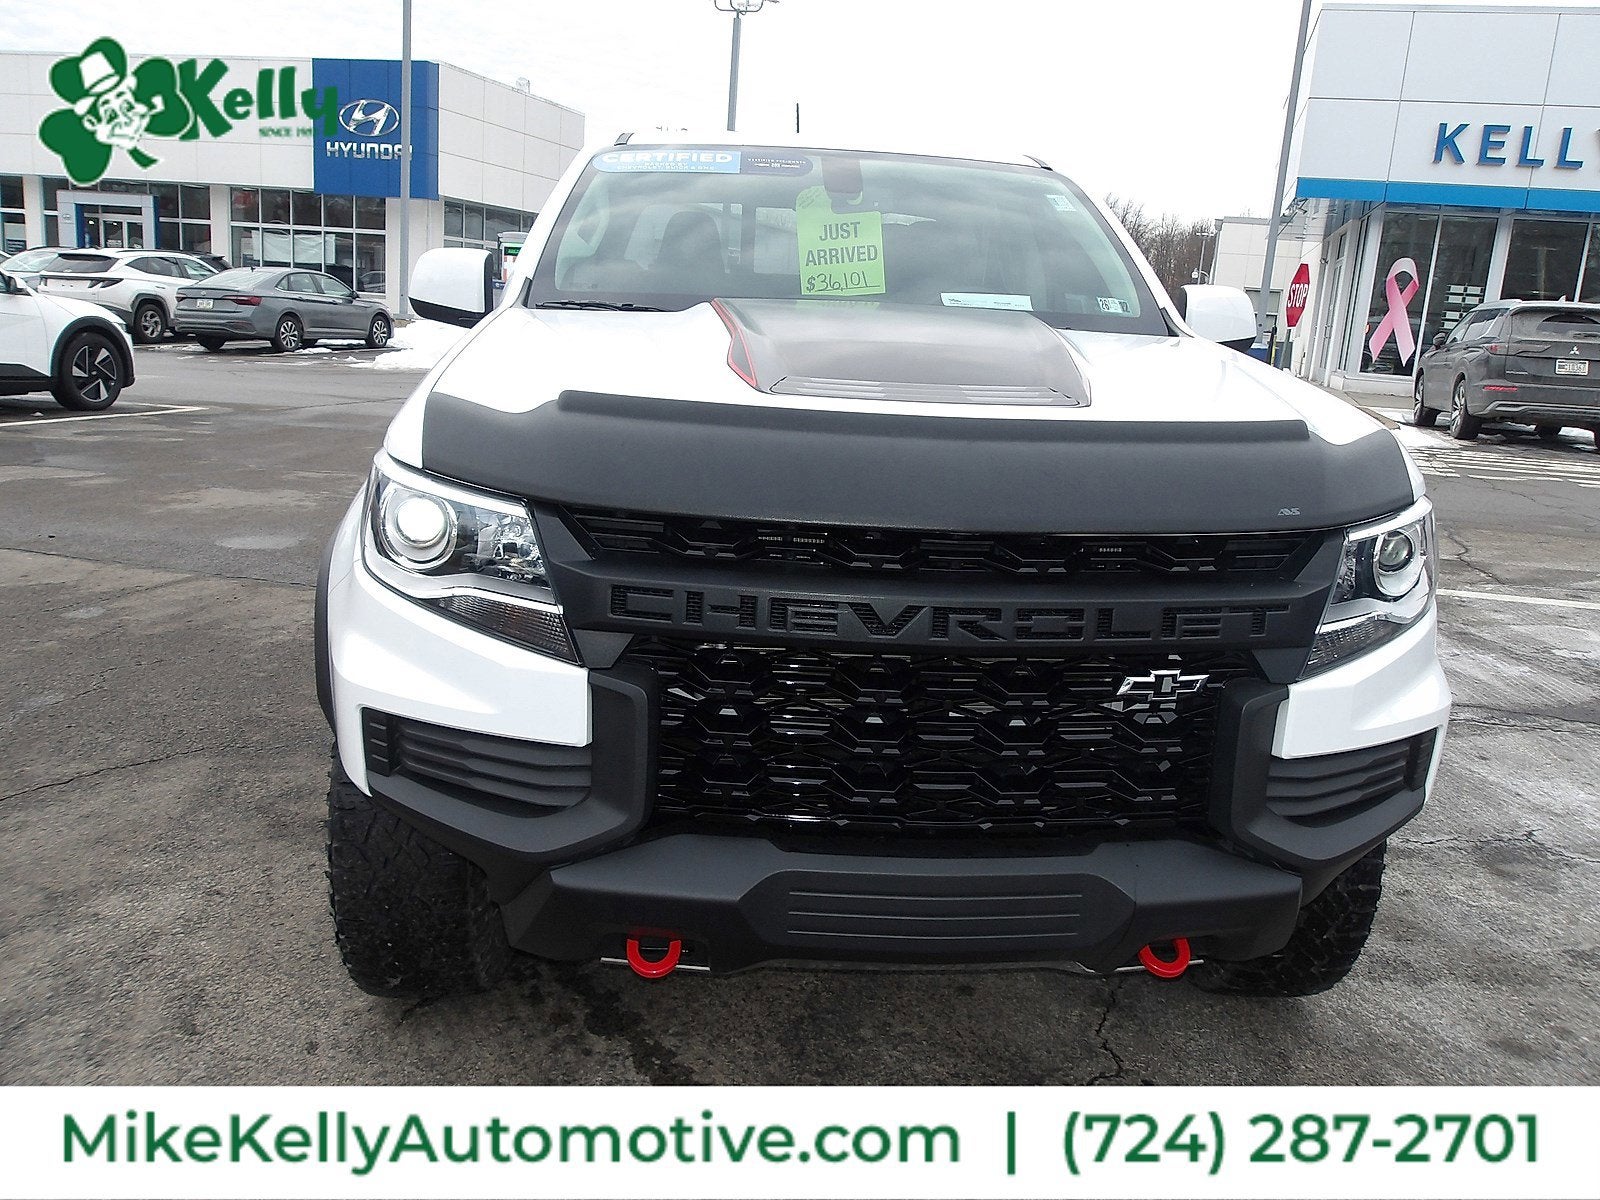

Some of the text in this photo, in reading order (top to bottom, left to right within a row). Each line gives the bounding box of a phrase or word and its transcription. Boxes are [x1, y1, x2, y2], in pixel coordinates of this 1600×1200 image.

[602, 151, 733, 163] CERTIFIED
[1432, 122, 1600, 169] KELL
[819, 221, 861, 241] JUST
[805, 244, 878, 266] ARRIVED
[806, 270, 868, 293] $36,101
[1287, 283, 1309, 308] STOP
[608, 584, 1291, 642] CHEVROLET
